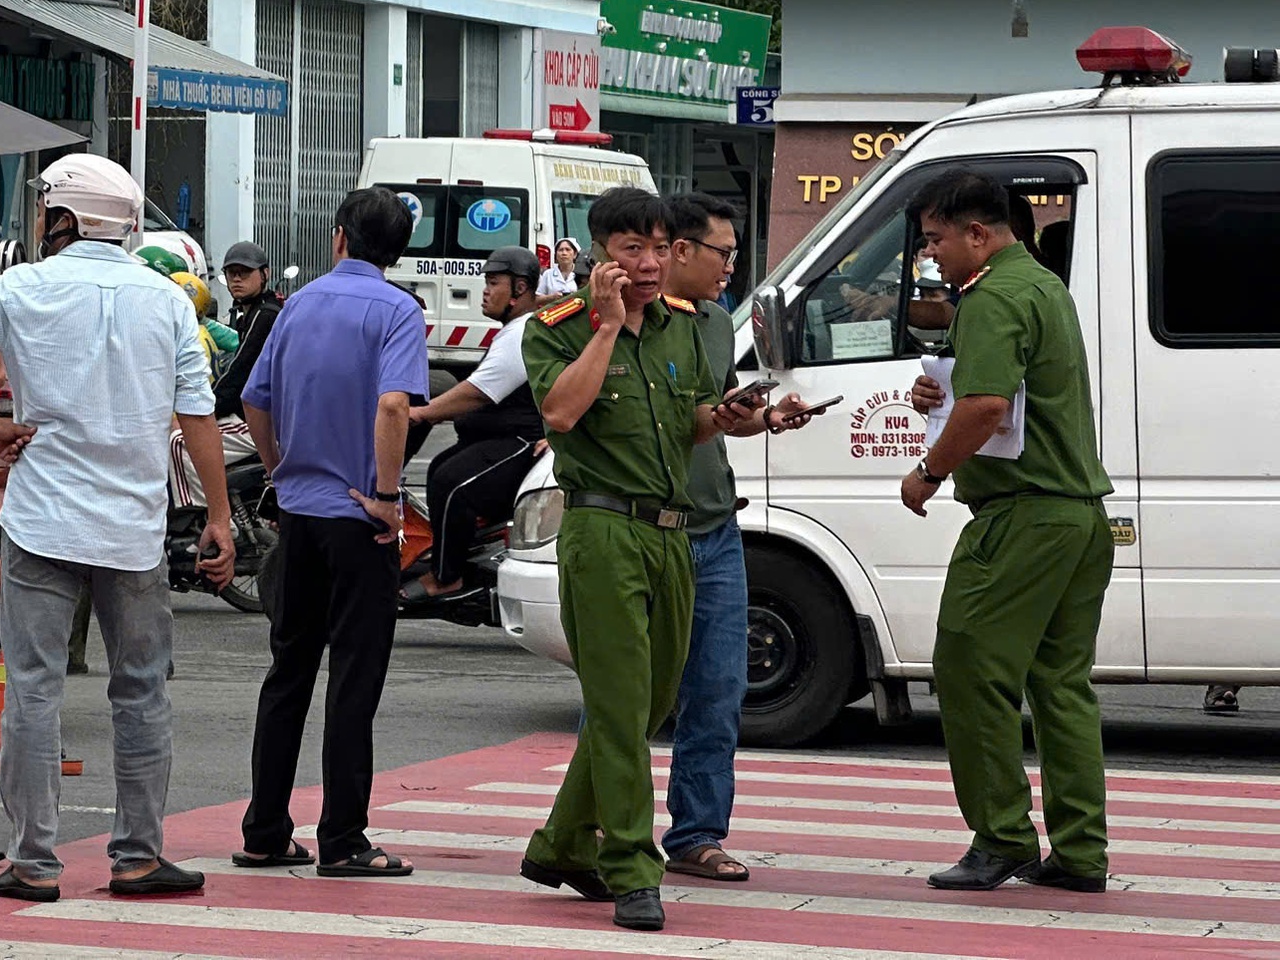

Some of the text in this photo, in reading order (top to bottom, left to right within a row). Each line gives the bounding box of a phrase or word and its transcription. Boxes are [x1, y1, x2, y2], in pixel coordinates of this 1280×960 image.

[544, 49, 564, 86] KHOA
[566, 41, 582, 88] CẤP
[797, 176, 842, 203] TP
[851, 407, 867, 430] CẤP
[885, 416, 909, 430] KV4
[850, 433, 878, 444] MDN:
